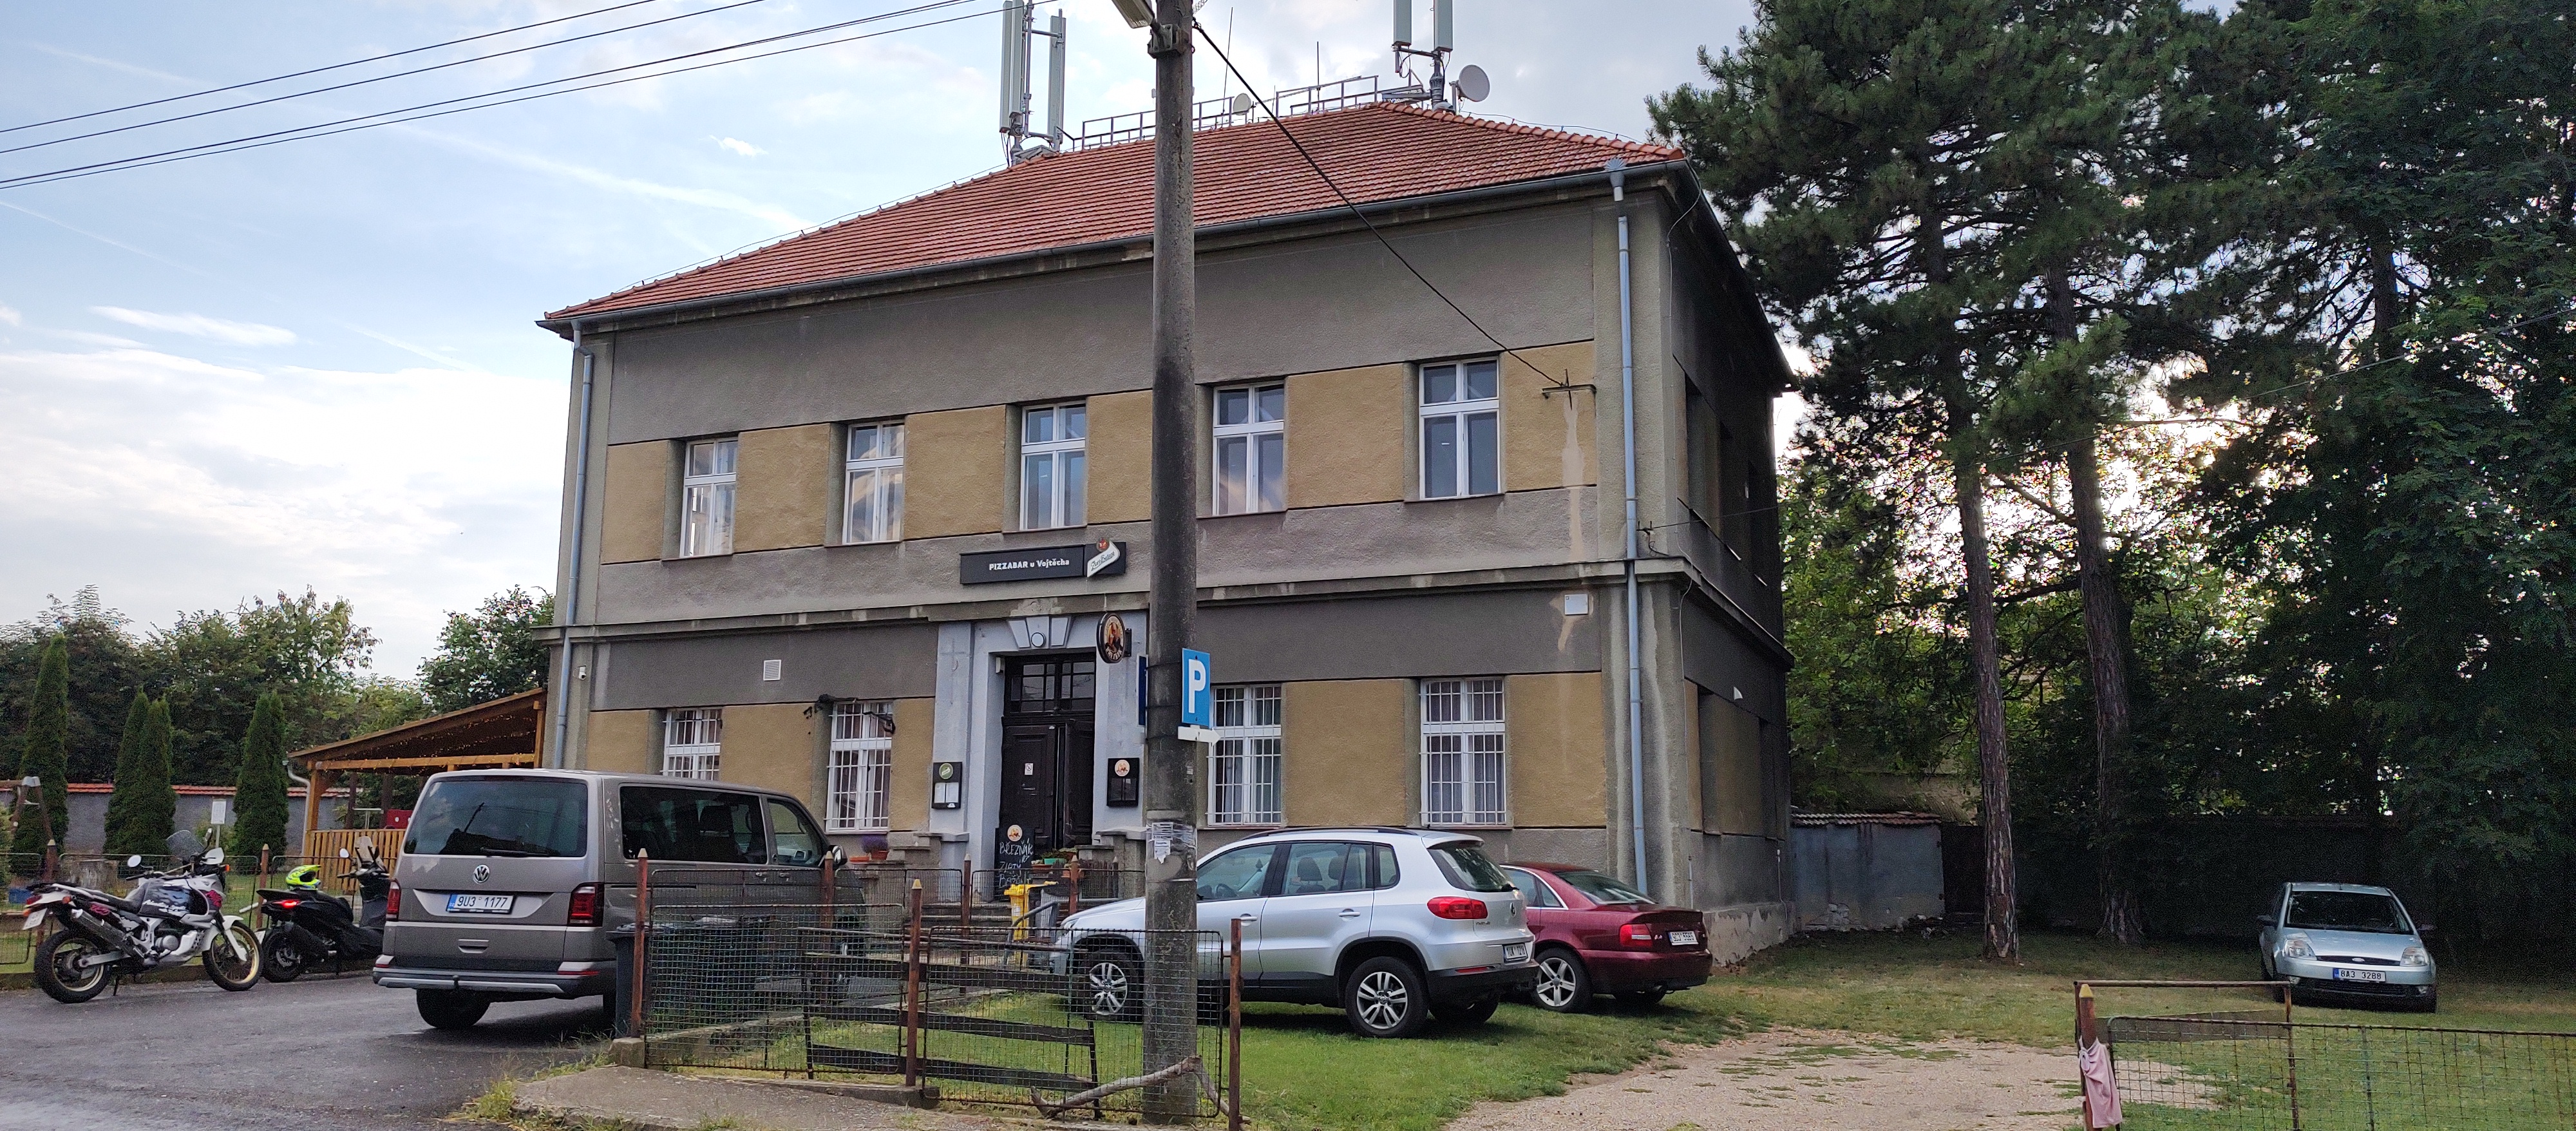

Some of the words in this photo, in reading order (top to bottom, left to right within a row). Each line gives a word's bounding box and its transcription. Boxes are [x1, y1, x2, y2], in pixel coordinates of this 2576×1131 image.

[989, 561, 1028, 571] PIZZABAR
[1036, 558, 1070, 568] Vojtěcha
[1188, 659, 1206, 713] P
[457, 896, 476, 907] 9U3
[484, 897, 508, 908] 1177
